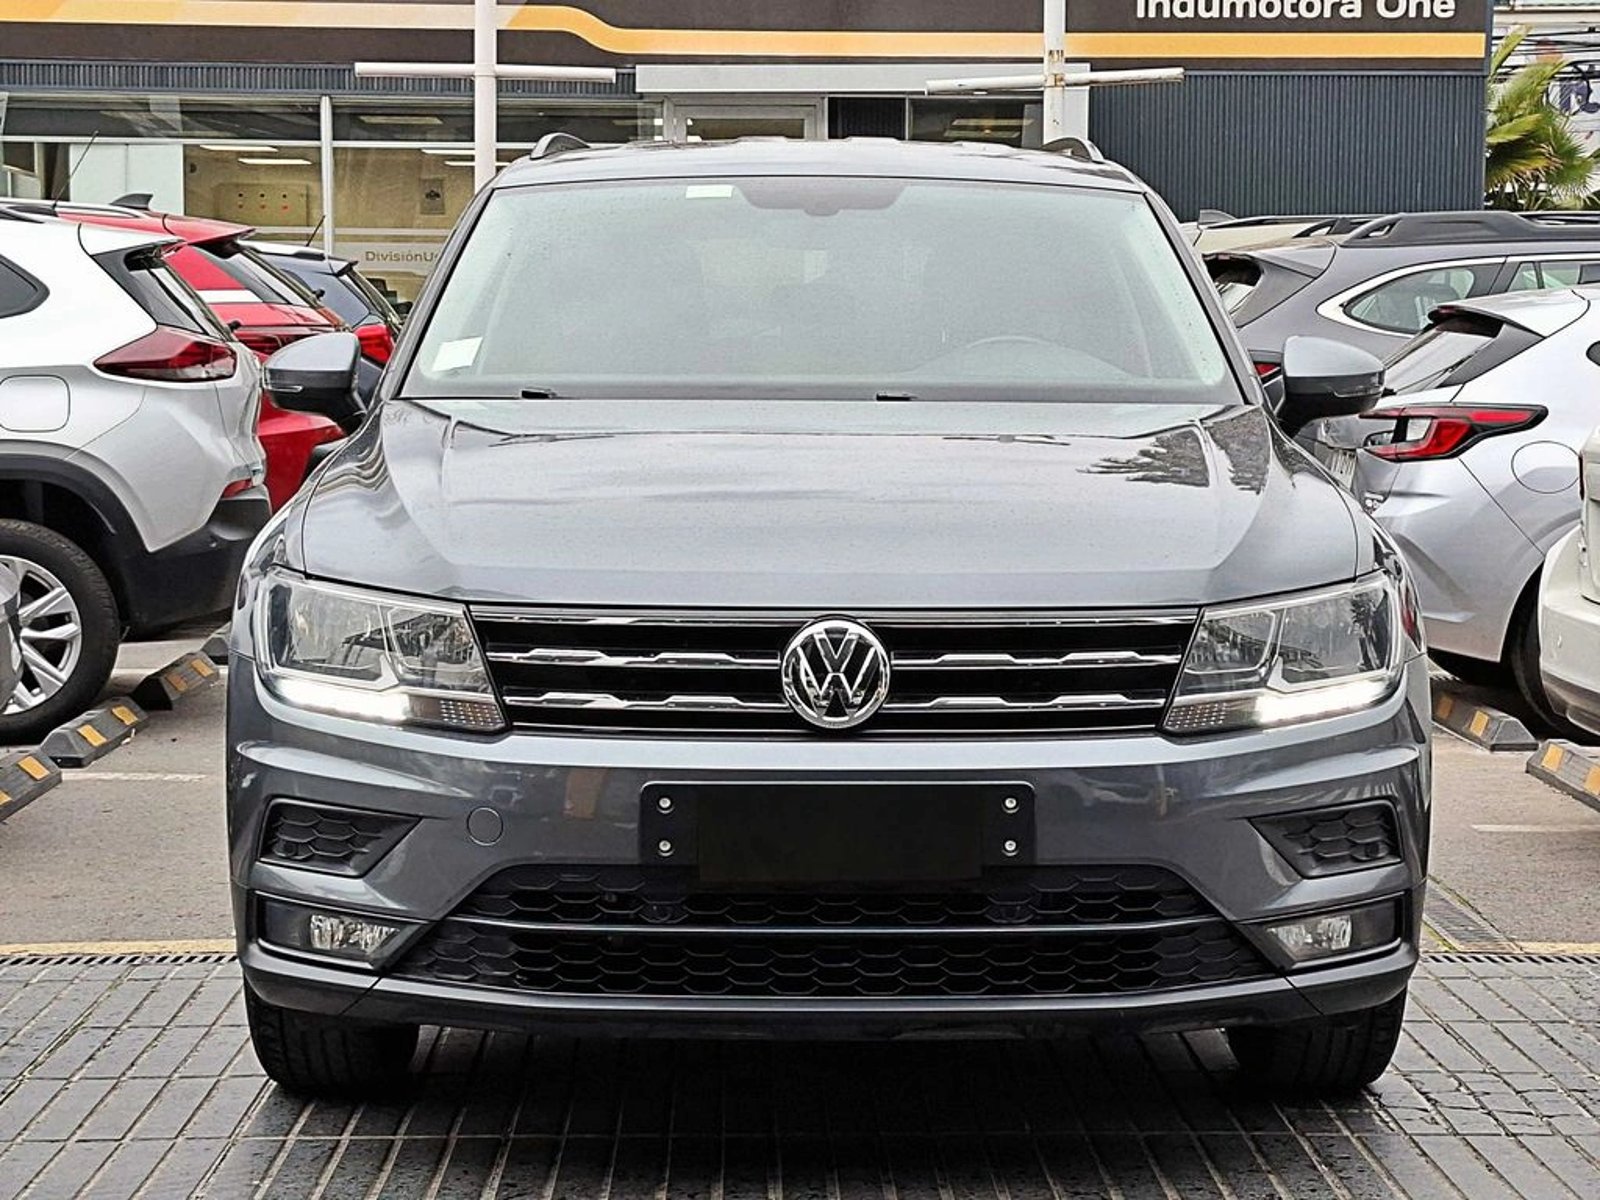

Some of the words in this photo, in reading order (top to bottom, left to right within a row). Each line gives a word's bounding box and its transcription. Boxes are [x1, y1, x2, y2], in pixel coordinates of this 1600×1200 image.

[1136, 0, 1362, 18] Indumotora
[1376, 0, 1456, 18] One
[785, 623, 887, 724] VW
